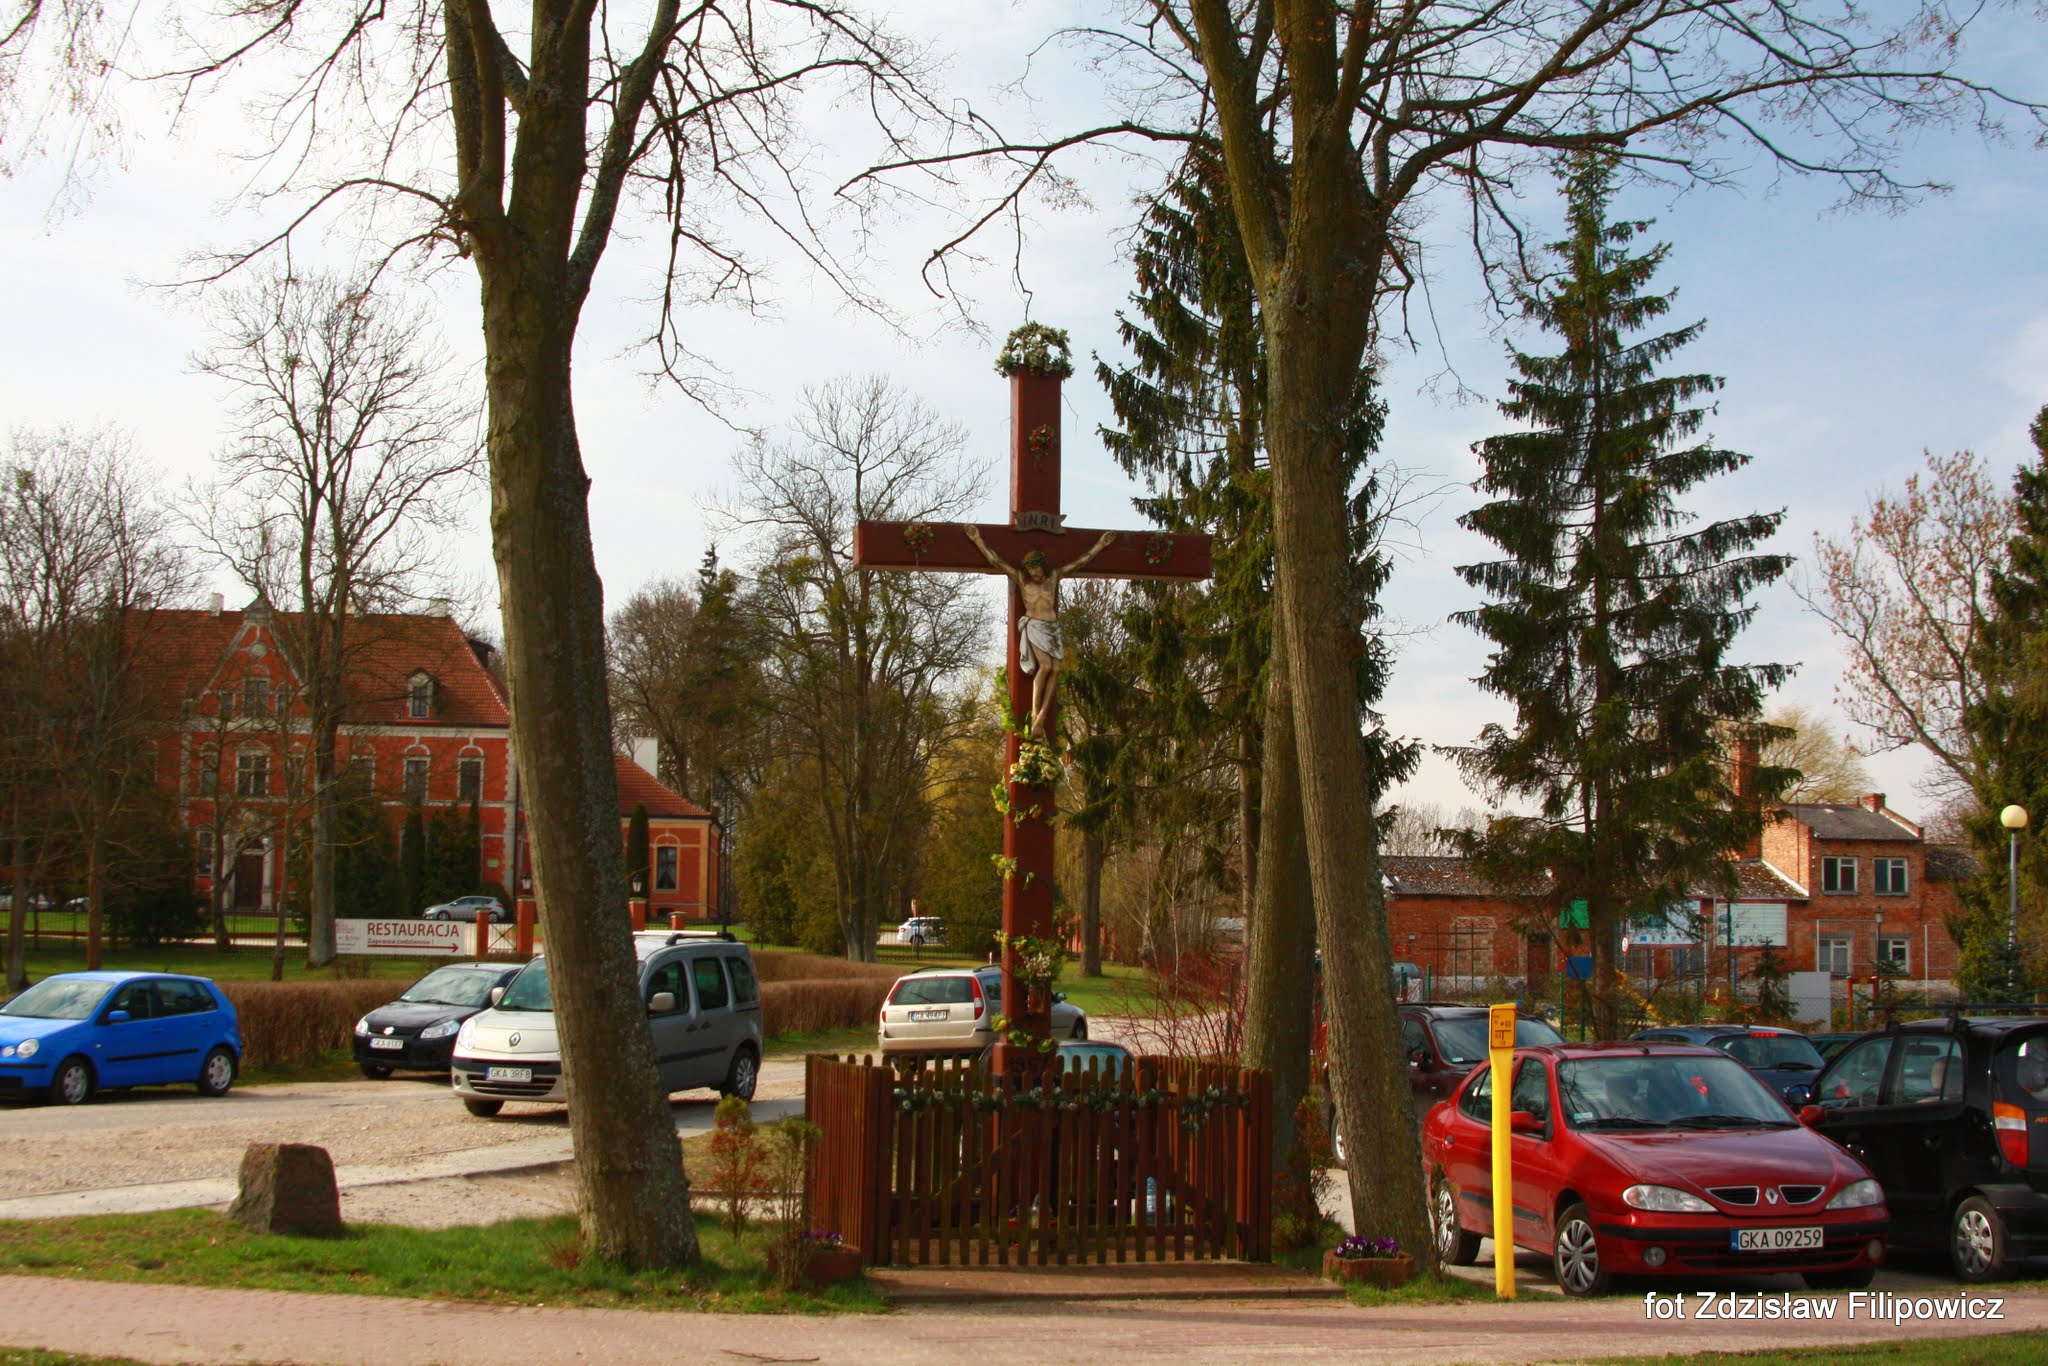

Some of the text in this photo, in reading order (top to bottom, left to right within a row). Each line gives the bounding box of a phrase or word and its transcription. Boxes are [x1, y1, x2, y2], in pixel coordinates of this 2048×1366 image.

[1023, 513, 1056, 529] INRI
[367, 922, 460, 937] RESTAURACJA
[490, 1068, 508, 1078] GKA
[1739, 1231, 1770, 1249] GKA
[1774, 1229, 1822, 1247] 09259
